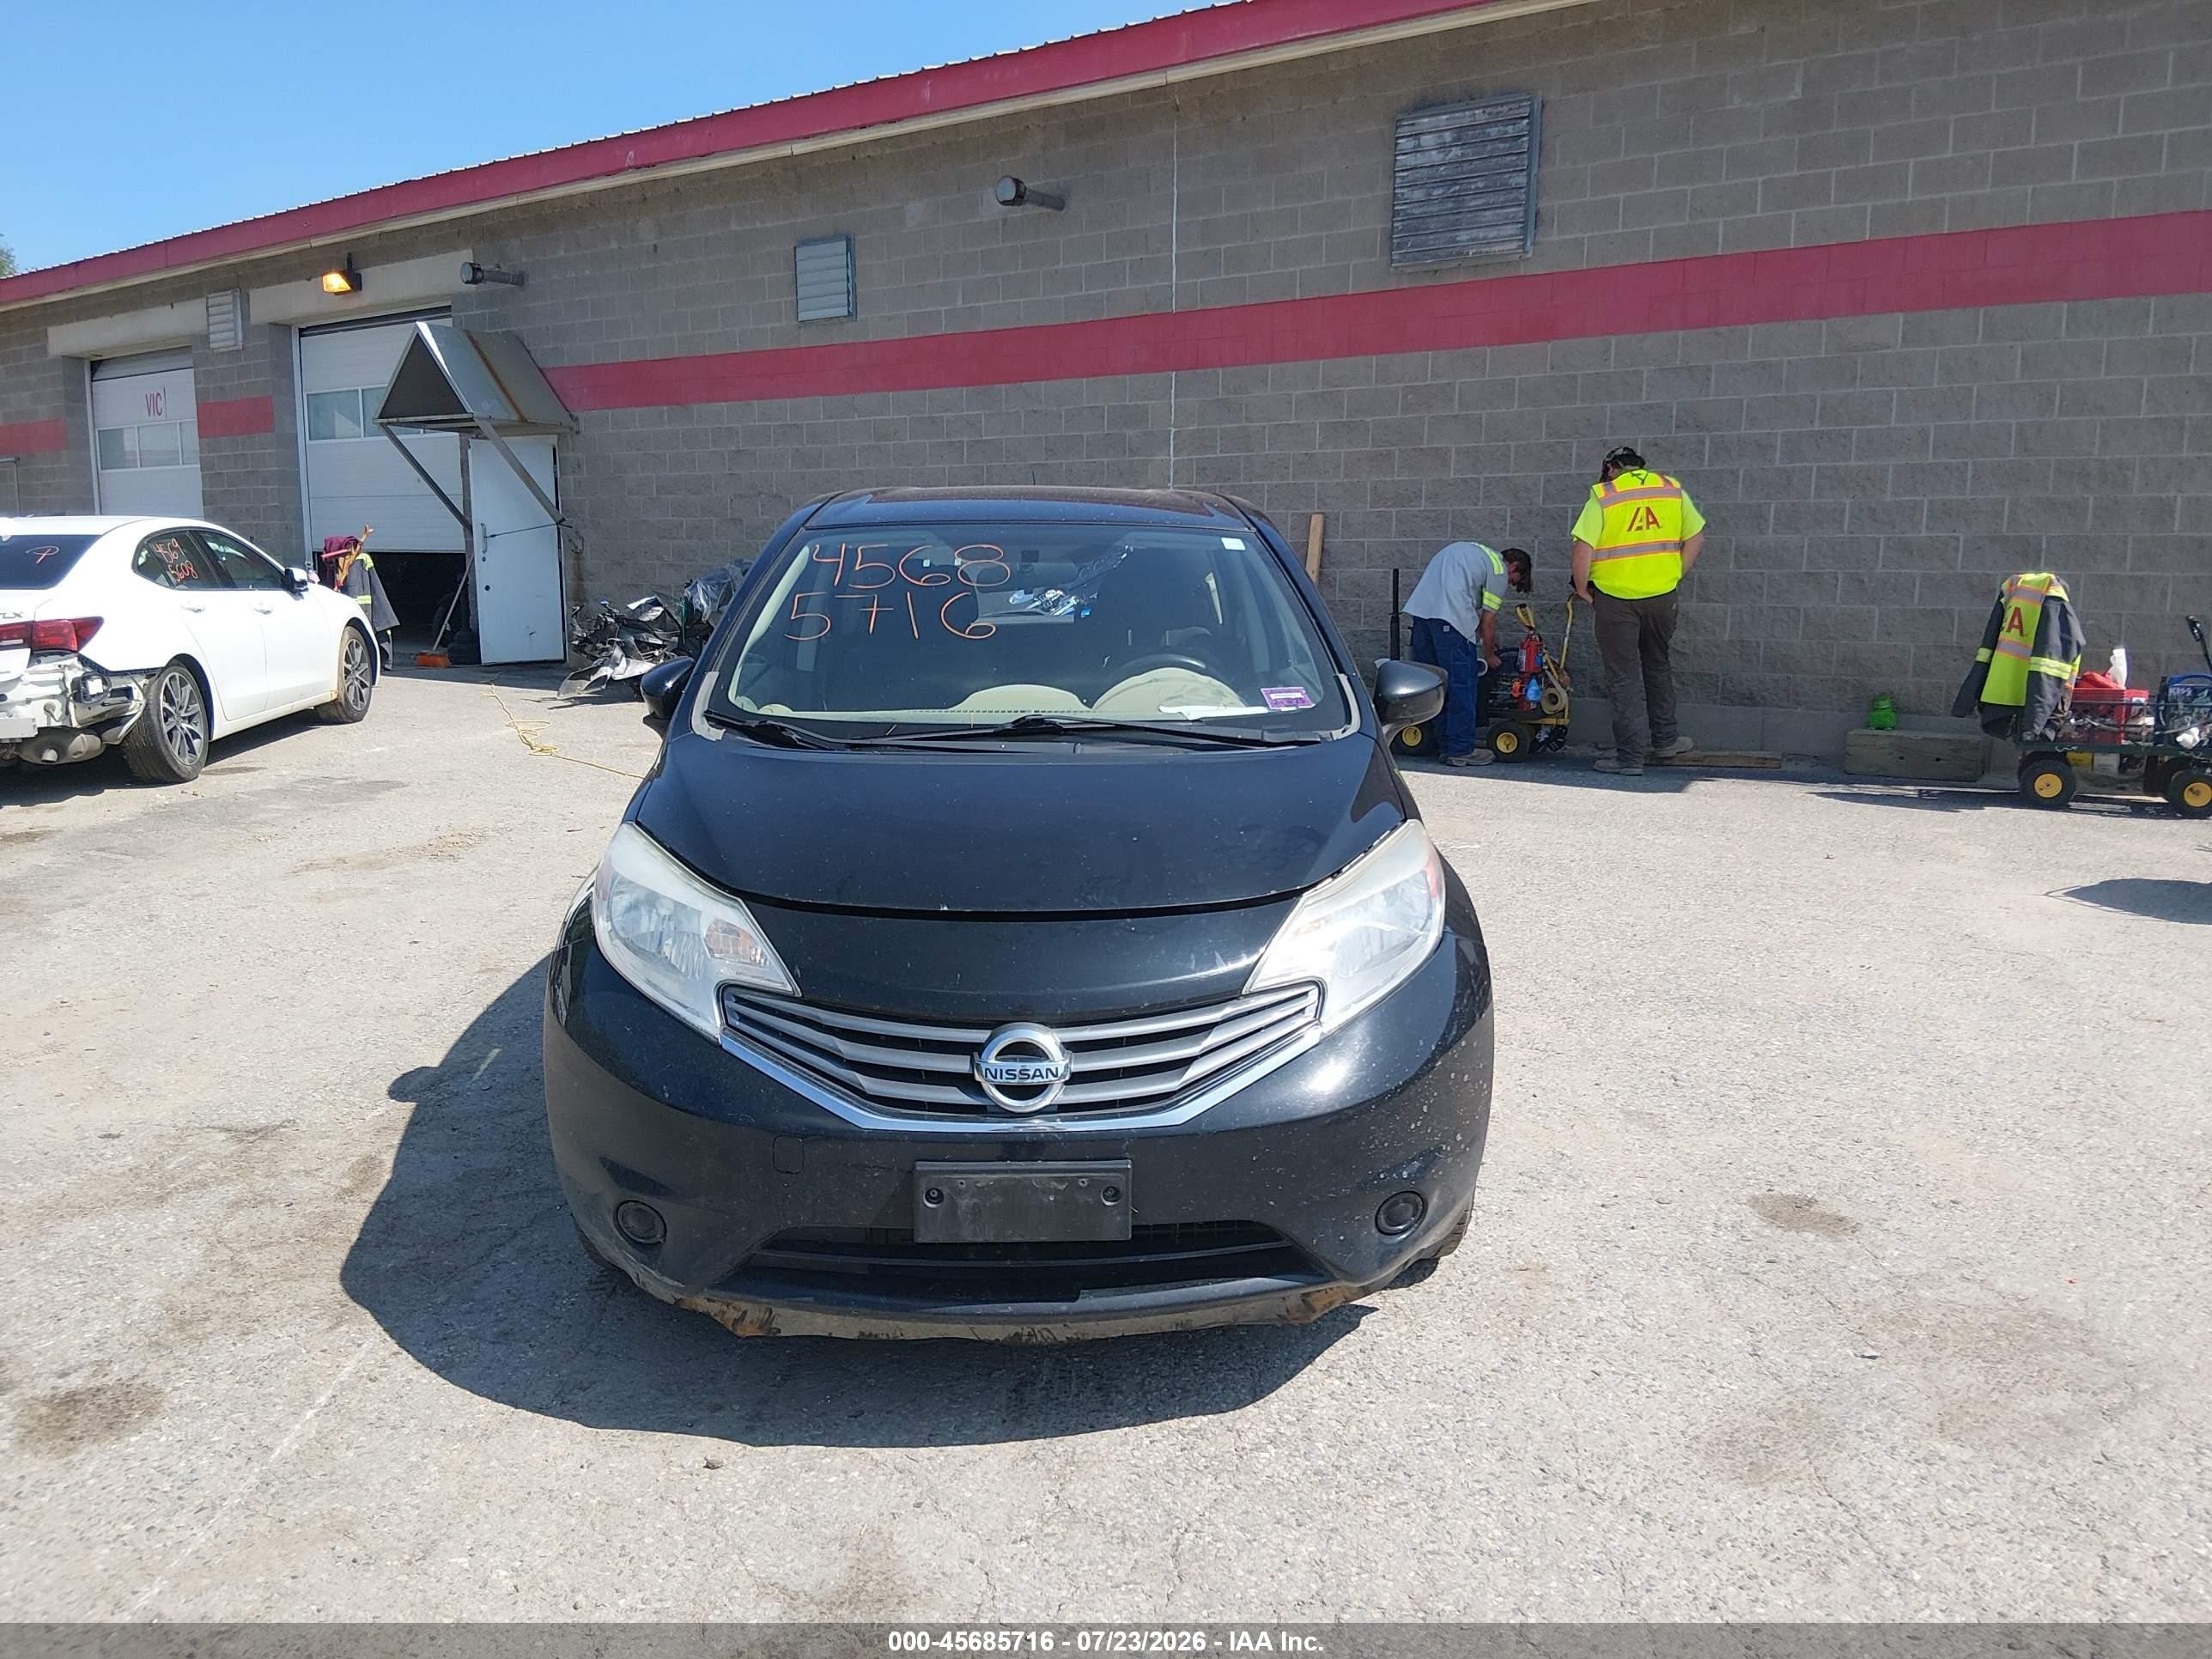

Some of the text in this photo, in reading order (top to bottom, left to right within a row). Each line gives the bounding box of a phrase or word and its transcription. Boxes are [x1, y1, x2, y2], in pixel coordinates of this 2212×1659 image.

[152, 538, 188, 563] 4569
[812, 543, 1011, 588] 4568
[783, 591, 997, 641] 5716
[984, 1066, 1059, 1080] NISSAN
